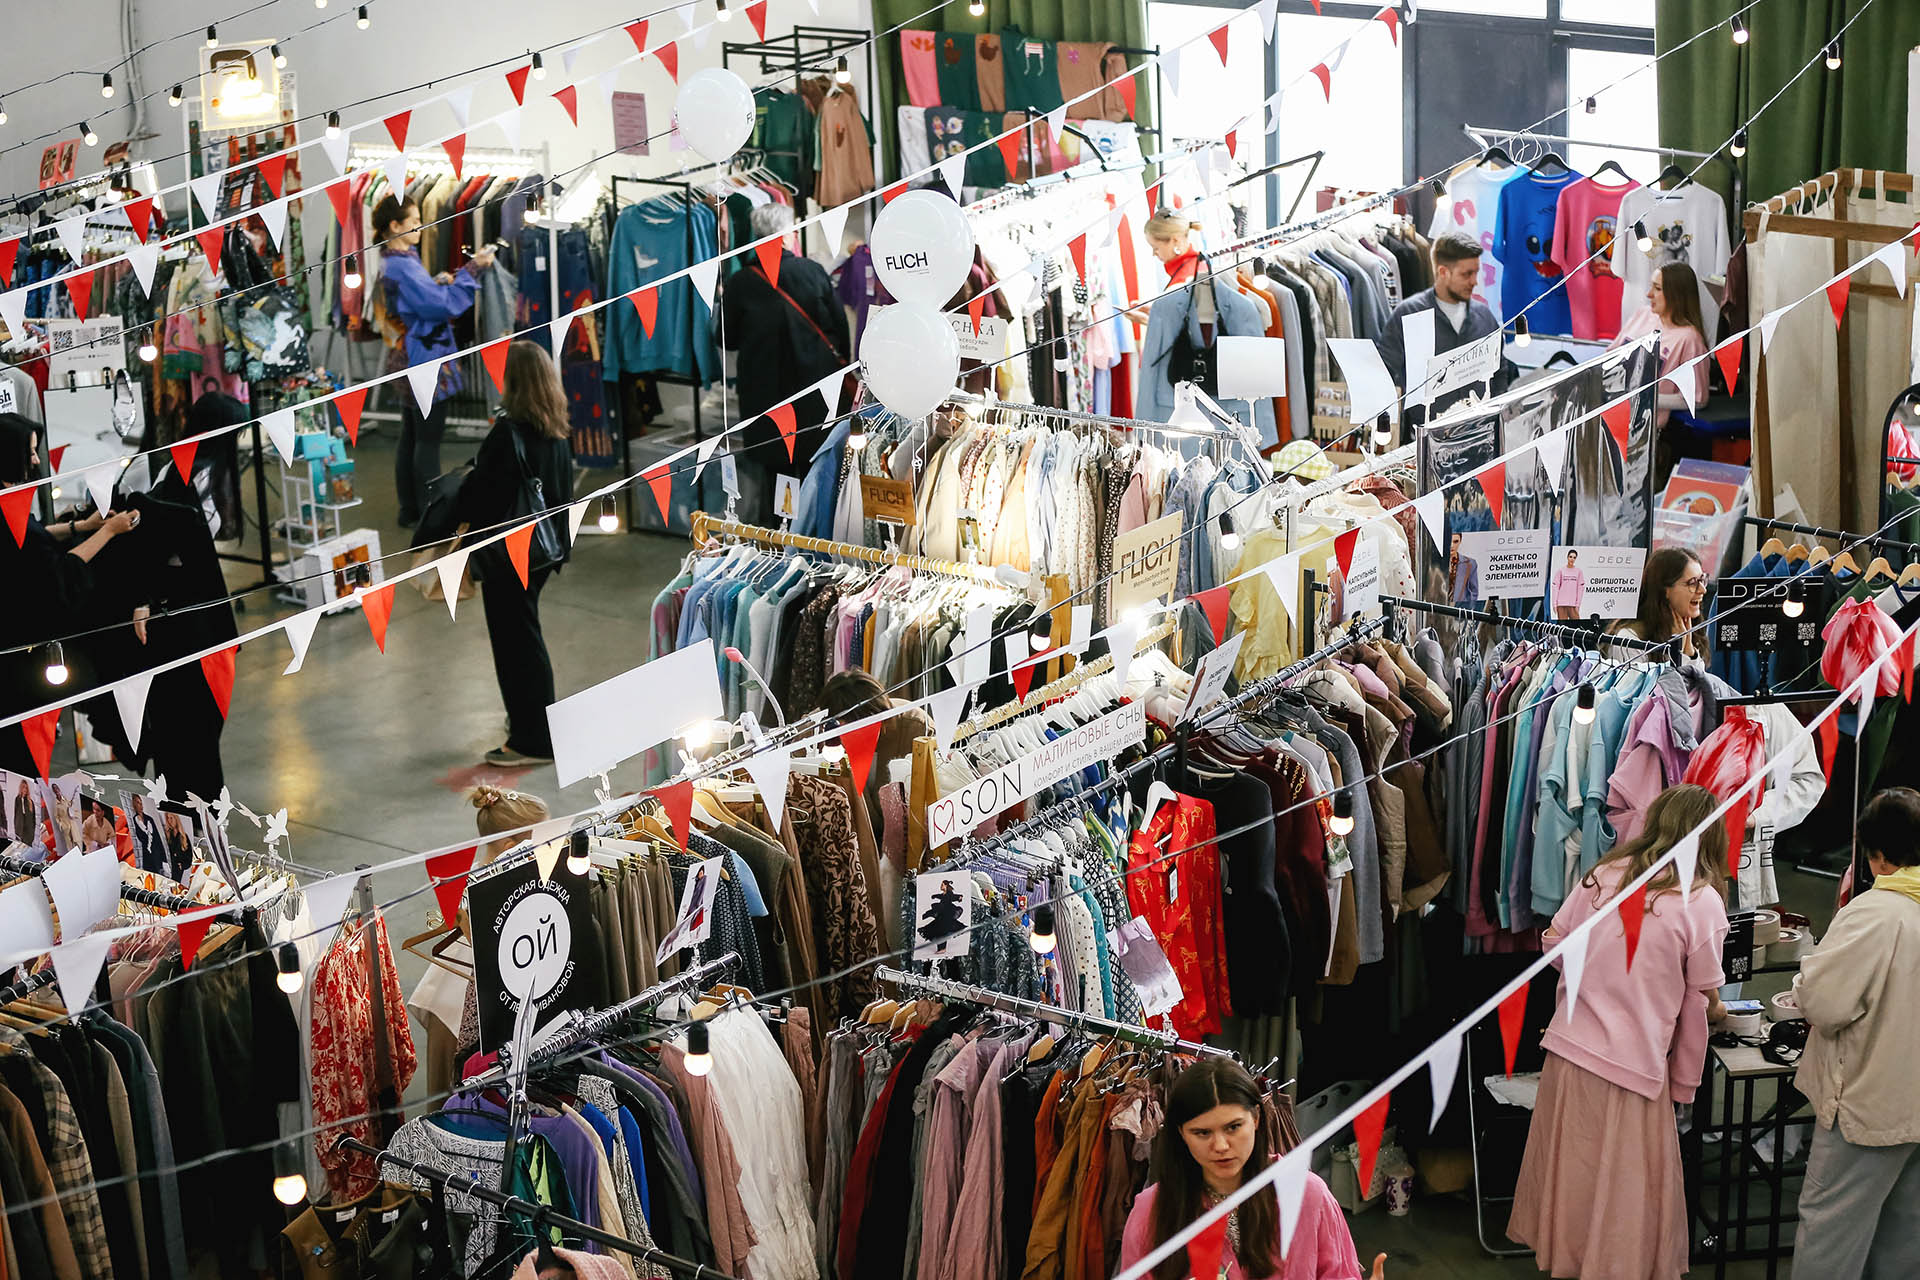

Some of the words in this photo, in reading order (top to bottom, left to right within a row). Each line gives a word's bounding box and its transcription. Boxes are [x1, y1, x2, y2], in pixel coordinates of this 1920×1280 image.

[886, 251, 928, 271] FLICH
[951, 319, 996, 336] CHKA
[870, 487, 906, 506] FLICH
[1121, 534, 1174, 584] FLICH
[1489, 562, 1537, 571] СЪЕМНЫМИ
[1490, 554, 1525, 562] ЖАКЕТЫ
[1485, 571, 1539, 581] ЭЛЕМЕНТАМИ
[1590, 577, 1629, 585] СВИТШОТЫ
[1733, 583, 1807, 598] DED
[1032, 719, 1111, 773] МАЛИНОВЫЕ
[1115, 703, 1143, 730] СНЫ
[1033, 766, 1064, 788] КОМФОРТ
[961, 763, 1021, 825] SON
[493, 879, 536, 934] АВТОРСКАЯ
[537, 879, 571, 905] ОДЕЖДА
[512, 914, 557, 969] ОЙ
[499, 990, 512, 1006] ОТ
[535, 961, 576, 1011] ИВАНОВОЙ
